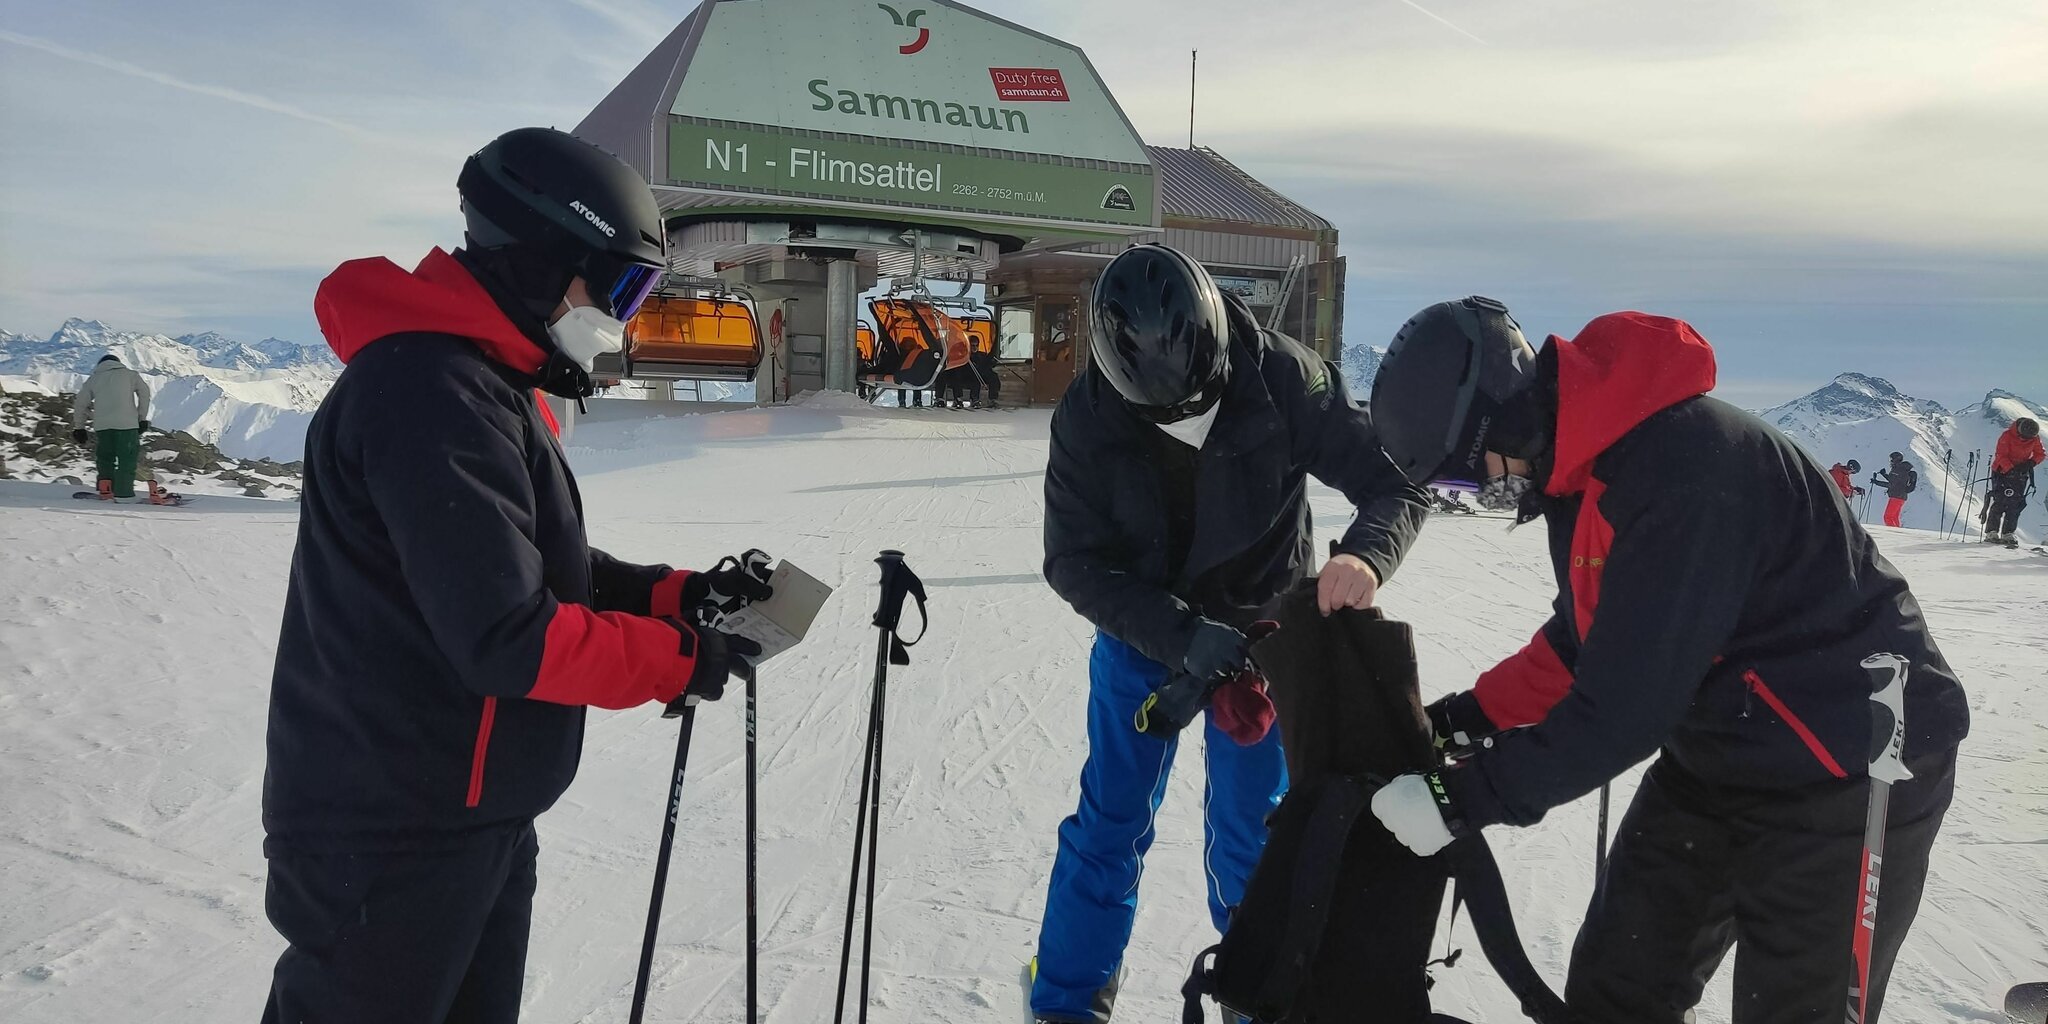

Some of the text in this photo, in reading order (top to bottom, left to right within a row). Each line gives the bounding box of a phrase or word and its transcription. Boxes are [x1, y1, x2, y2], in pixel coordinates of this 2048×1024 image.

[995, 71, 1058, 87] Duty free
[1001, 87, 1063, 97] samnaun.ch
[807, 78, 1030, 134] Samnaun
[706, 138, 748, 173] N1
[790, 147, 941, 193] Flimsattel
[952, 183, 978, 196] 2262
[987, 187, 1012, 200] 2752
[569, 200, 616, 238] ATOMIC
[1466, 415, 1491, 470] ATOMIC
[1890, 720, 1904, 760] LEKI
[670, 768, 686, 825] LEKI
[1861, 852, 1882, 931] LEKI
